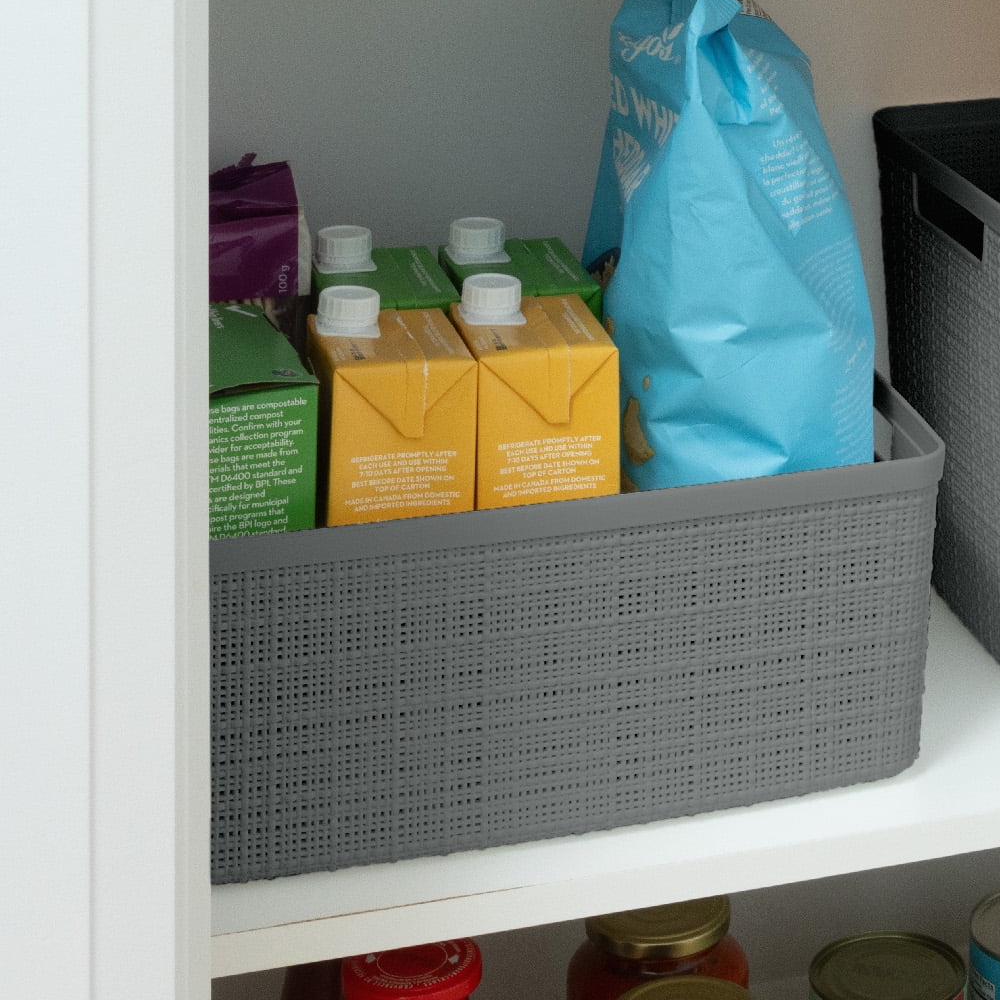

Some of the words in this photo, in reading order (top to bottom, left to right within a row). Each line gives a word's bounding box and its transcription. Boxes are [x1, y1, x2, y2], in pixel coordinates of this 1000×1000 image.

[278, 274, 288, 293] 100
[221, 405, 240, 414] bags
[256, 397, 307, 410] compostable
[250, 410, 283, 420] compost
[232, 422, 264, 432] Confirm
[266, 419, 283, 428] with
[284, 419, 302, 428] your
[230, 432, 269, 442] collection
[270, 429, 303, 439] program
[220, 455, 239, 463] bags
[256, 449, 278, 459] made
[279, 448, 298, 456] from
[397, 451, 432, 459] PROMPTLY
[233, 463, 248, 471] that
[250, 461, 270, 469] meet
[517, 464, 542, 472] BEFORE
[548, 468, 576, 476] CARTON
[221, 472, 250, 482] D6400
[252, 467, 286, 478] standard
[288, 465, 302, 474] and
[209, 482, 242, 493] certified
[244, 482, 253, 490] by
[273, 478, 296, 486] These
[493, 484, 512, 492] MADE
[521, 480, 549, 488] CANADA
[518, 486, 552, 495] IMPORTED
[553, 483, 597, 491] INGREDIENTS
[229, 489, 265, 501] designed
[251, 496, 288, 507] municipal
[406, 499, 451, 507] INGREDIENTS
[229, 511, 267, 522] programs
[239, 520, 252, 529] BPI
[254, 520, 271, 528] logo
[273, 515, 288, 525] and
